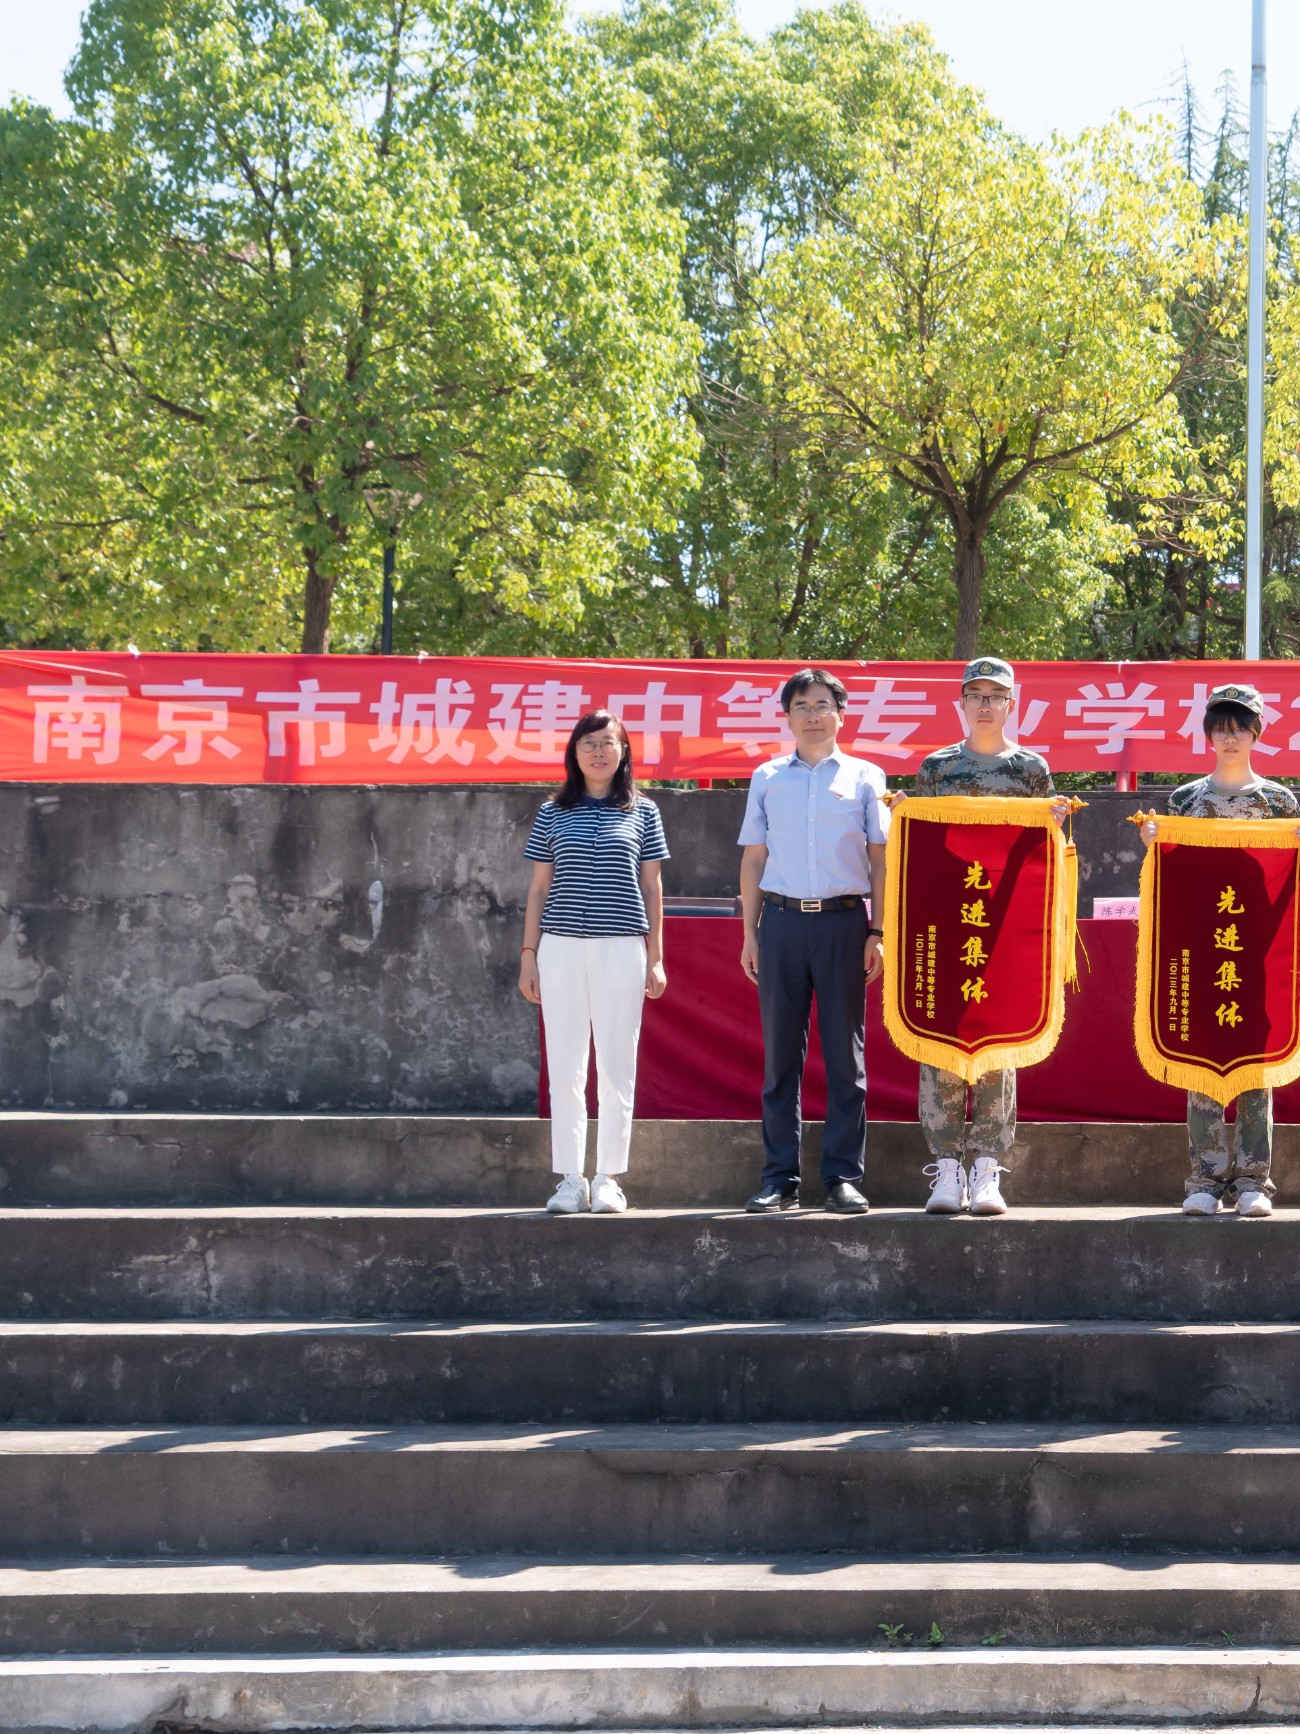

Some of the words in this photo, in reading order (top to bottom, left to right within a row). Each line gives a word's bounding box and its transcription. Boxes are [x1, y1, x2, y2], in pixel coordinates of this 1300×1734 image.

[927, 925, 937, 1019] 南京市城建中等专业学校
[959, 860, 992, 1004] 先进集体
[1213, 885, 1245, 1029] 先进集体
[1180, 949, 1191, 1042] 南京市城建中等专业学校
